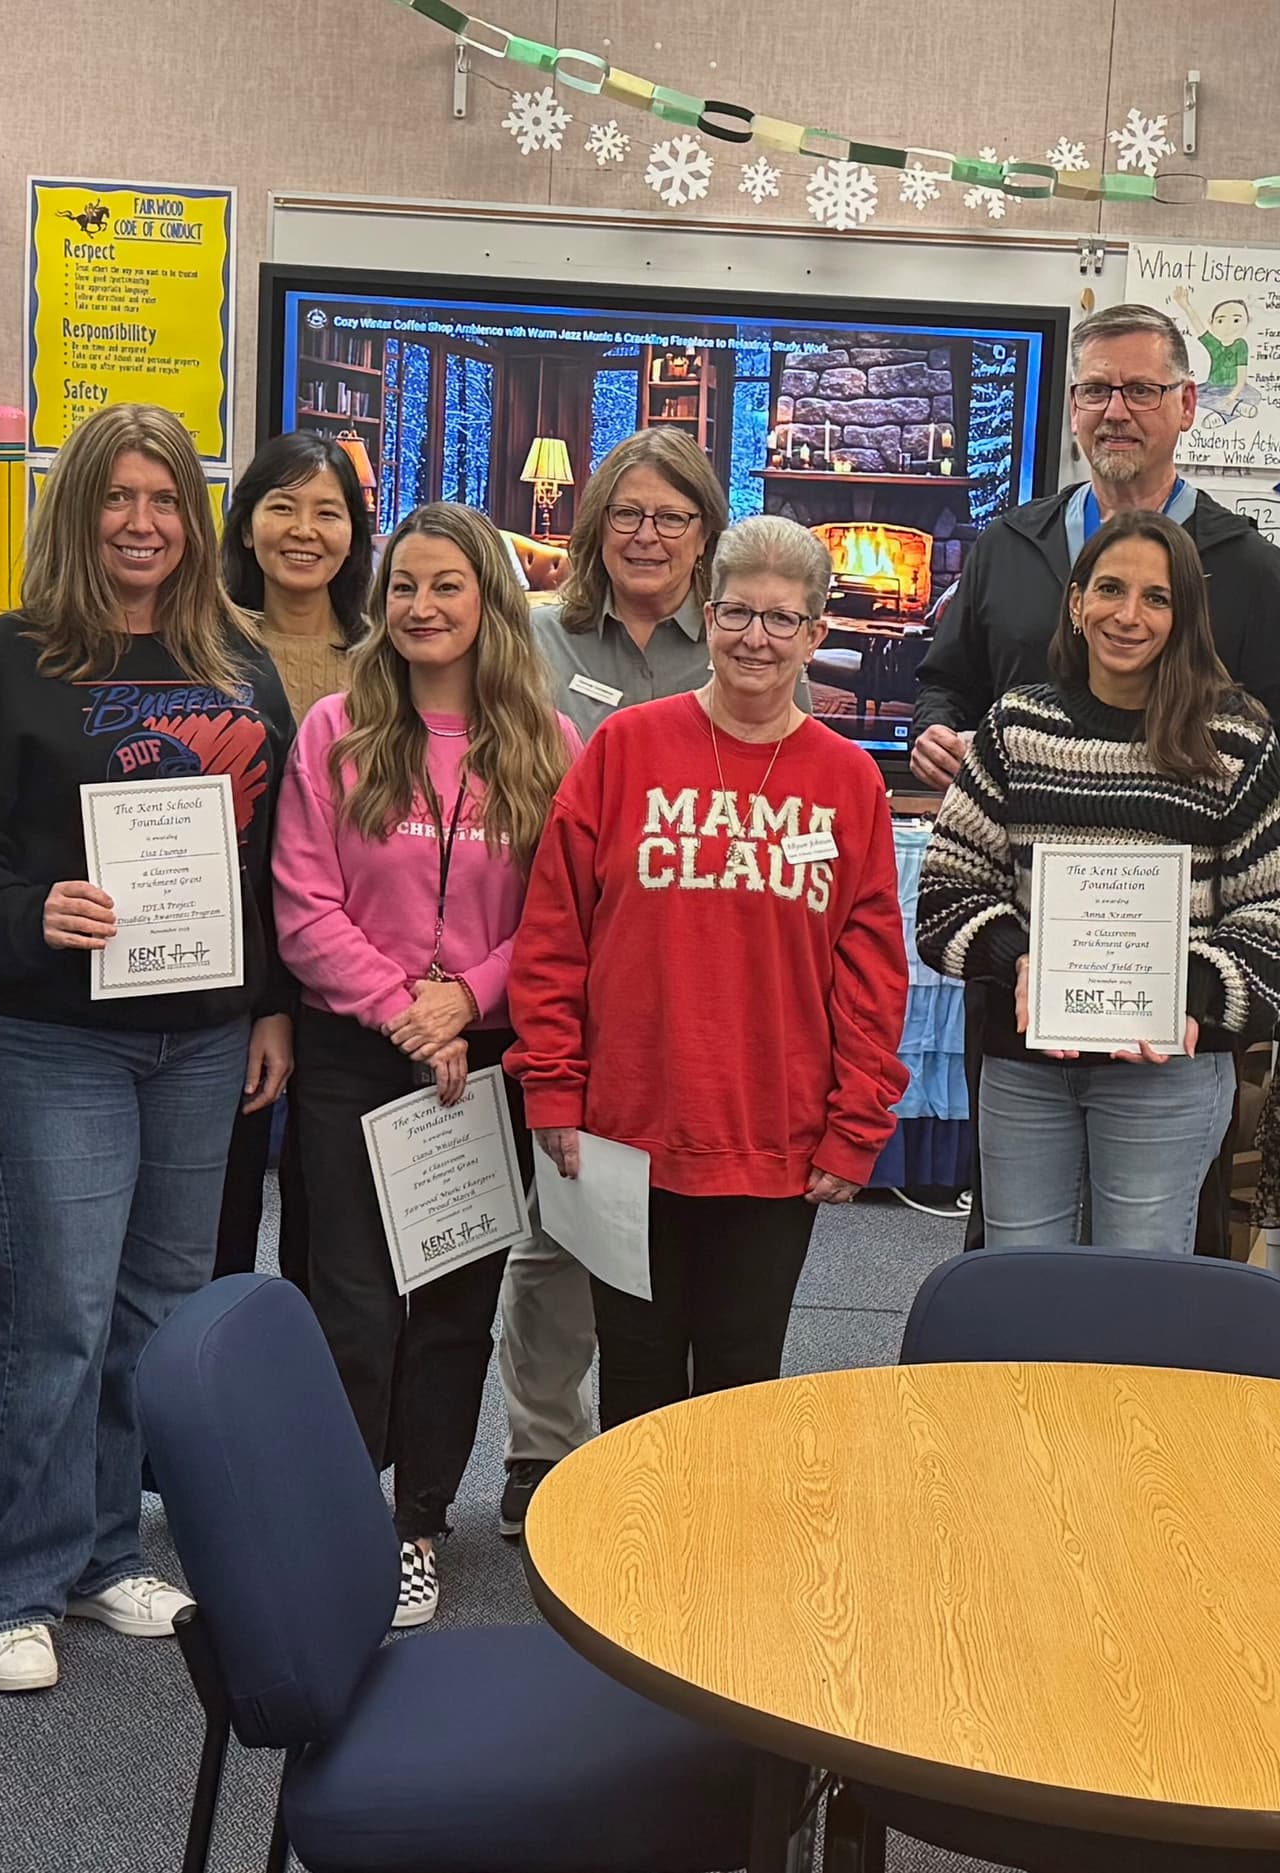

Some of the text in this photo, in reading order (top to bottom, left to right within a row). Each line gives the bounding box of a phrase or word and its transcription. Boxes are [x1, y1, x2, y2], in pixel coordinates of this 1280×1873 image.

[134, 198, 183, 217] FAIRWOOD
[114, 219, 202, 240] CODE OF CONDUCT
[64, 239, 115, 263] Respect
[1138, 250, 1196, 279] What
[63, 318, 156, 344] Responsibility
[334, 316, 358, 329] Cozy
[394, 320, 426, 332] Coffee
[428, 322, 453, 334] Shop
[505, 327, 526, 337] with
[528, 328, 557, 338] Warm
[558, 329, 582, 340] Jazz
[583, 331, 612, 342] Music
[614, 333, 622, 342] &
[624, 333, 669, 346] Crackling
[670, 336, 714, 348] Fireplace
[716, 338, 726, 348] to
[64, 379, 108, 403] Safety
[1189, 429, 1245, 450] Students
[1224, 451, 1255, 464] Whole
[117, 739, 162, 773] BUF
[114, 799, 203, 815] The Kent Schools
[643, 787, 835, 840] MAMA
[129, 816, 191, 831] Foundation
[638, 837, 834, 913] CLAUS
[1067, 865, 1160, 877] The Kent Schools
[1080, 880, 1145, 891] Foundation
[128, 945, 166, 961] KENT
[1069, 962, 1153, 973] Preschool Field Trip
[1065, 989, 1104, 1001] KENT
[392, 1105, 436, 1131] The Kent
[407, 1109, 464, 1140] Foundation
[421, 1228, 454, 1252] KENT
